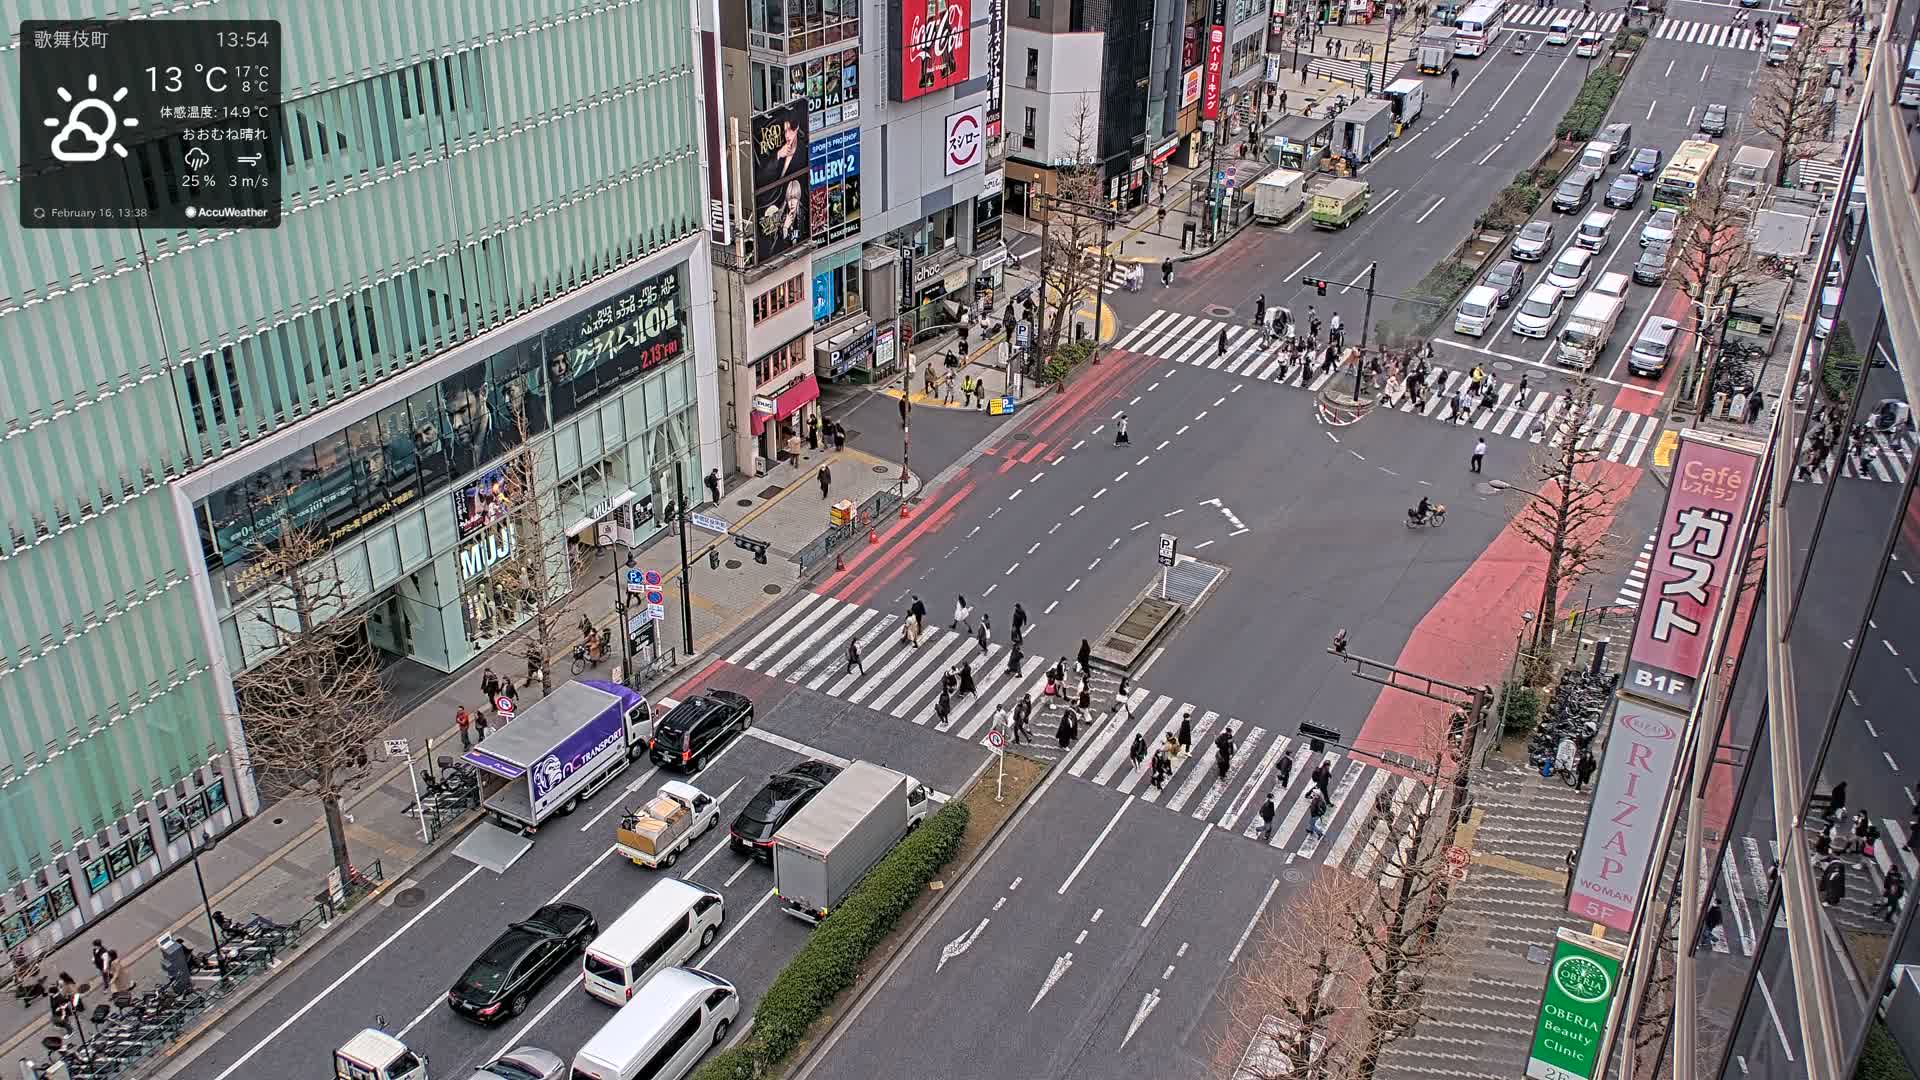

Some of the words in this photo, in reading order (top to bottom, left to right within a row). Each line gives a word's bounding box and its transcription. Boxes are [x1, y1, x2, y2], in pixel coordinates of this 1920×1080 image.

[1207, 44, 1222, 110] バーガーキング
[948, 132, 980, 152] スシロー
[711, 199, 723, 233] MUJI
[903, 249, 910, 257] P
[1019, 325, 1027, 335] P
[641, 343, 661, 369] 2.13
[664, 339, 678, 357] FRI
[831, 351, 840, 366] P
[1003, 399, 1009, 409] P
[1685, 461, 1742, 489] Café
[1681, 479, 1738, 501] レストラン
[593, 496, 615, 519] MUJI
[460, 521, 516, 580] MUJI
[1162, 539, 1170, 549] P
[630, 572, 637, 583] P
[1652, 507, 1730, 642] ガスト
[1634, 669, 1685, 695] B1F
[581, 727, 623, 765] TRANSPORT
[1600, 741, 1653, 881] RIZAP
[1580, 879, 1633, 904] WOMAN
[1584, 901, 1616, 920] 5F
[1561, 969, 1602, 991] OBERIA
[1544, 1004, 1599, 1032] OBERIA
[1544, 1020, 1593, 1046] Beauty
[1544, 1039, 1585, 1061] Clinic
